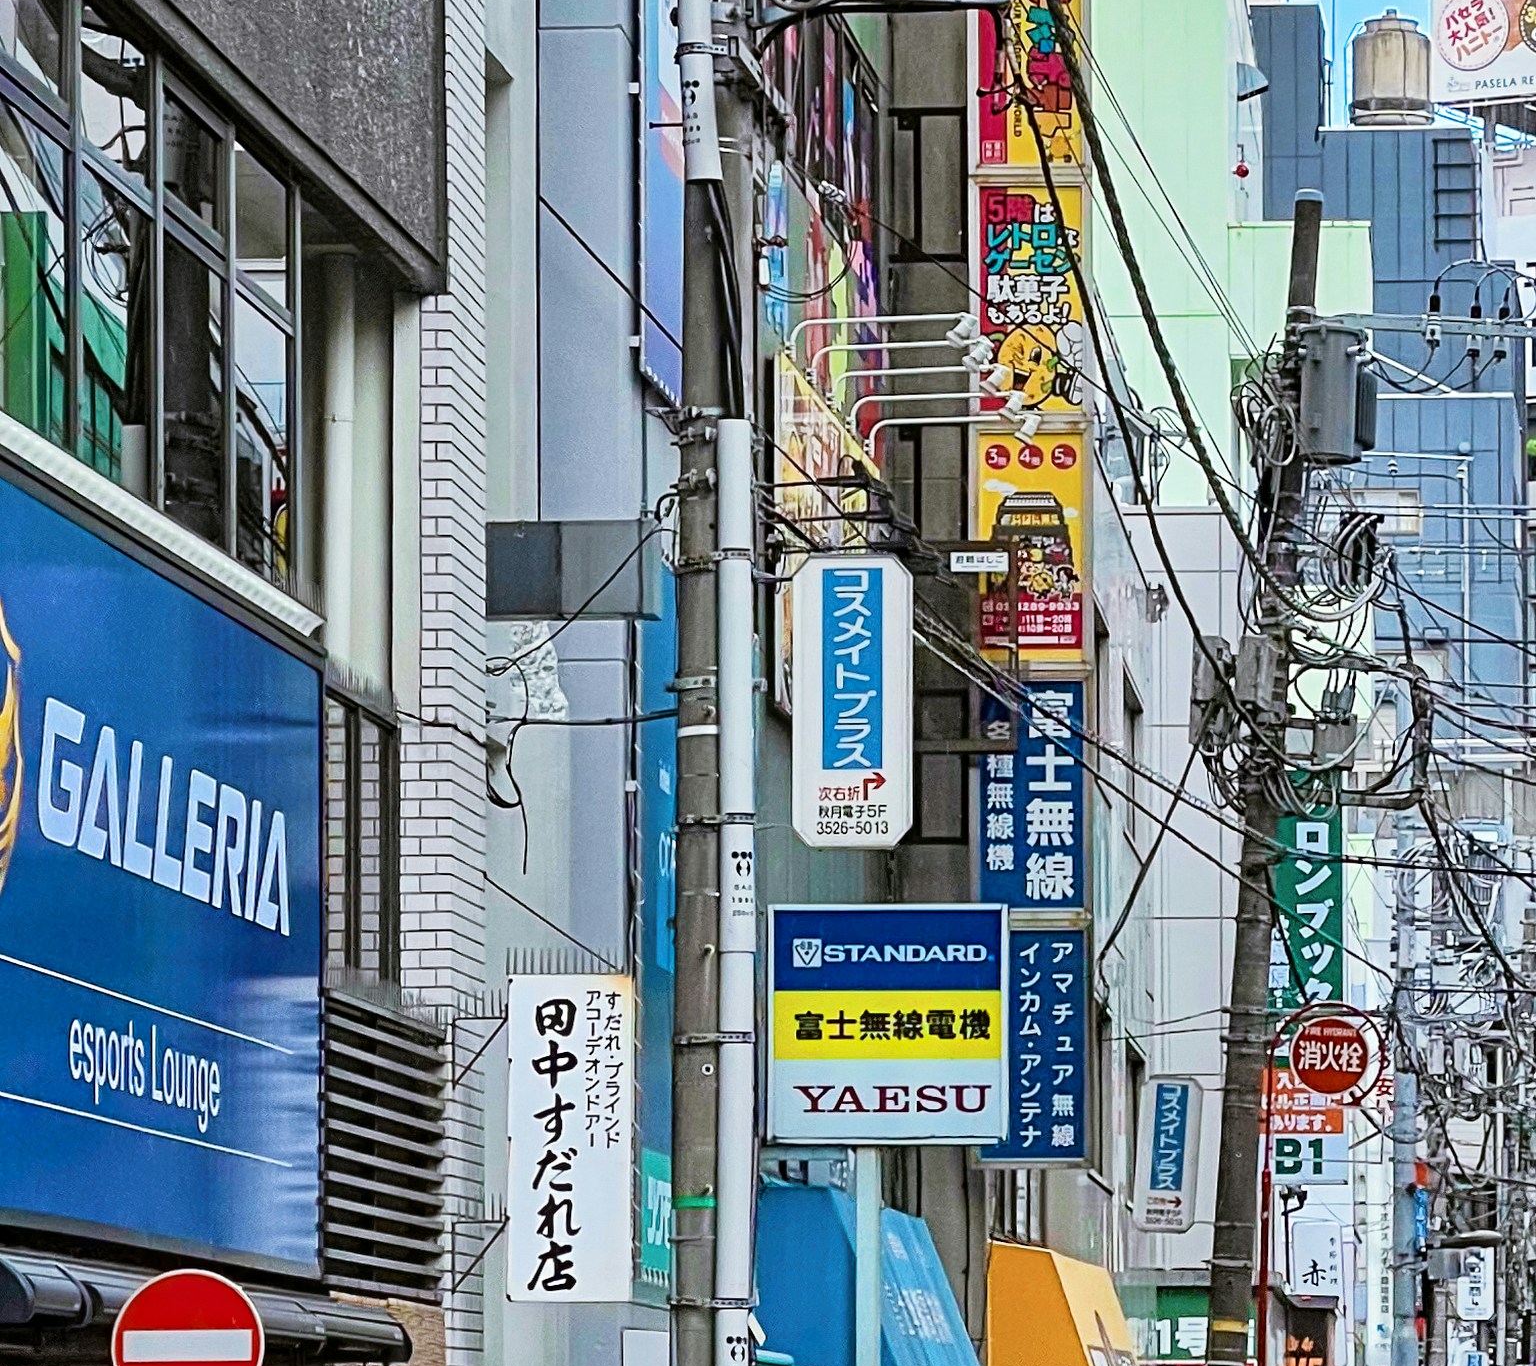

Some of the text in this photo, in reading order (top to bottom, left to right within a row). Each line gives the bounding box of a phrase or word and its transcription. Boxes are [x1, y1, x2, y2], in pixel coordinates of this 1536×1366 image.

[1475, 77, 1517, 91] PASELA
[986, 274, 1069, 303] 駄菓子
[832, 568, 872, 769] コスメイトプラス
[37, 697, 290, 937] GALLERIA
[816, 820, 889, 835] 3526-5013
[818, 786, 861, 802] 次右折
[818, 805, 887, 820] 秋月電子5F
[986, 721, 1015, 871] 各種無線機
[1025, 690, 1075, 901] 富士無線
[823, 944, 987, 962] STANDARD
[68, 1015, 221, 1134] esports Lounge
[585, 990, 602, 1148] アコーデオンドアー
[604, 990, 622, 1149] すだれ・ブラインド
[794, 1009, 991, 1041] 富士無線電機
[1019, 943, 1042, 1148] インカム・アンテナ
[1051, 942, 1075, 1147] アマチュア無線
[1298, 1040, 1364, 1073] 消火栓
[527, 998, 582, 1292] 田中すだれ店
[793, 1085, 992, 1113] YAESU
[1153, 1081, 1184, 1190] コスメイトプラス
[1275, 1138, 1325, 1176] B1
